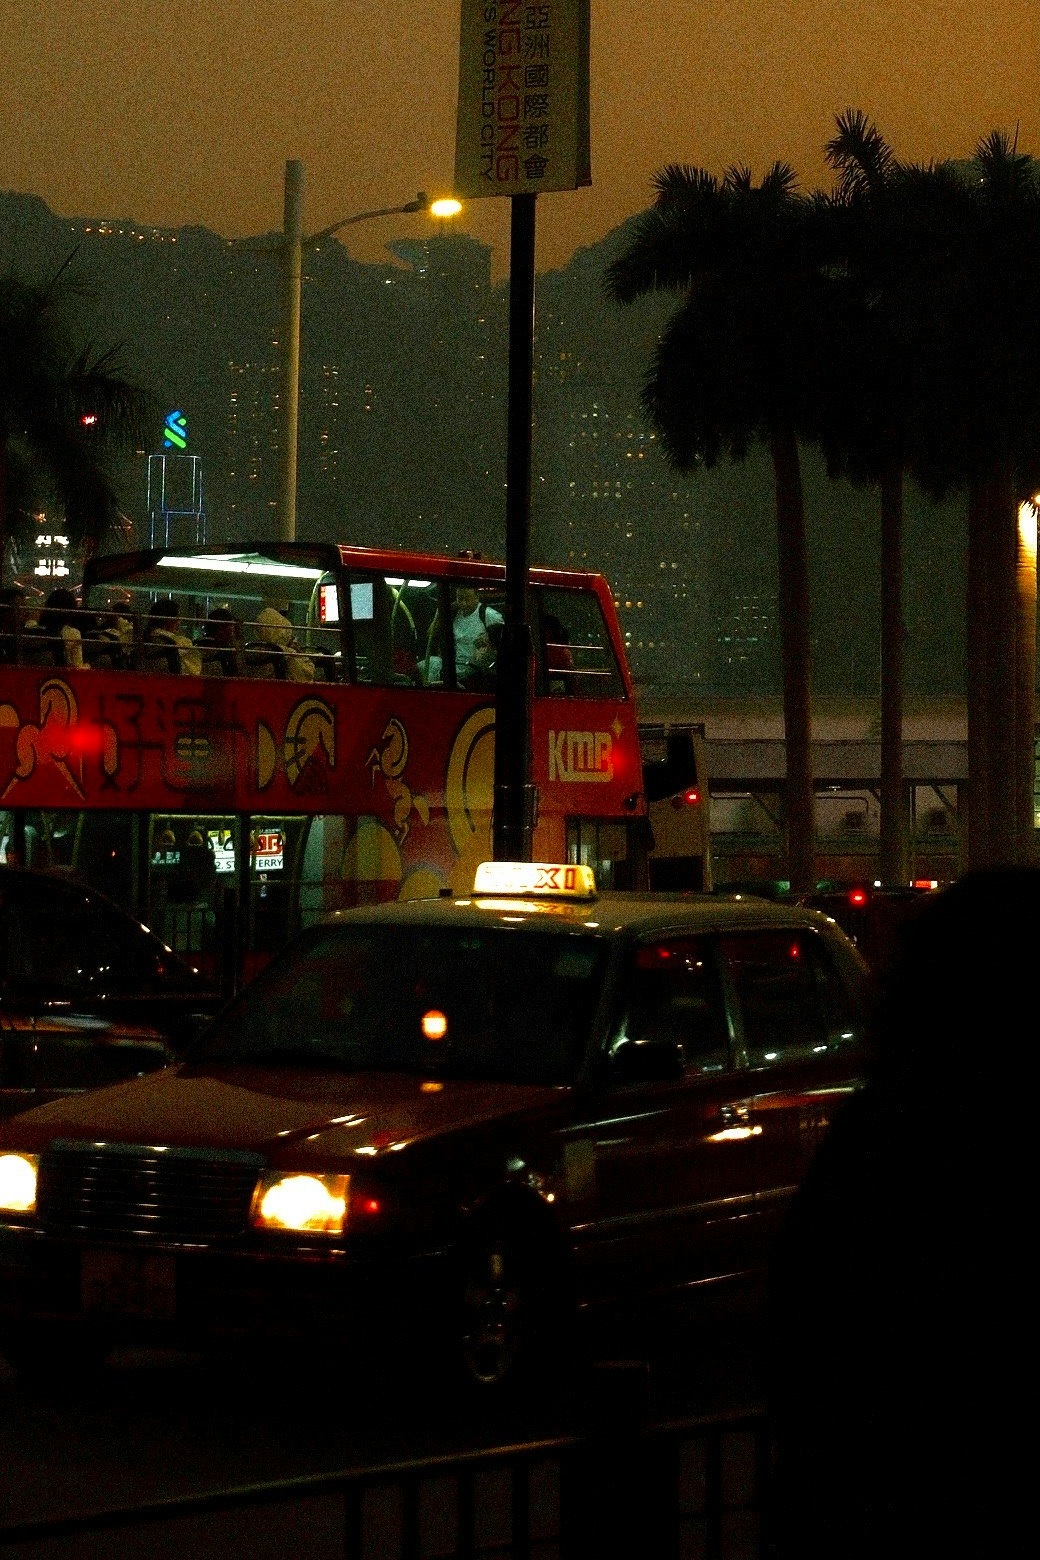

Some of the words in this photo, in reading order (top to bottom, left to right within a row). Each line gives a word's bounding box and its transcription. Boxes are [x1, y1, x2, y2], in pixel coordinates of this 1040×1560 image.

[481, 28, 497, 117] WORLD
[480, 123, 494, 181] CITY
[496, 65, 521, 182] KONG
[548, 729, 614, 782] KMB
[255, 858, 284, 869] ERRY
